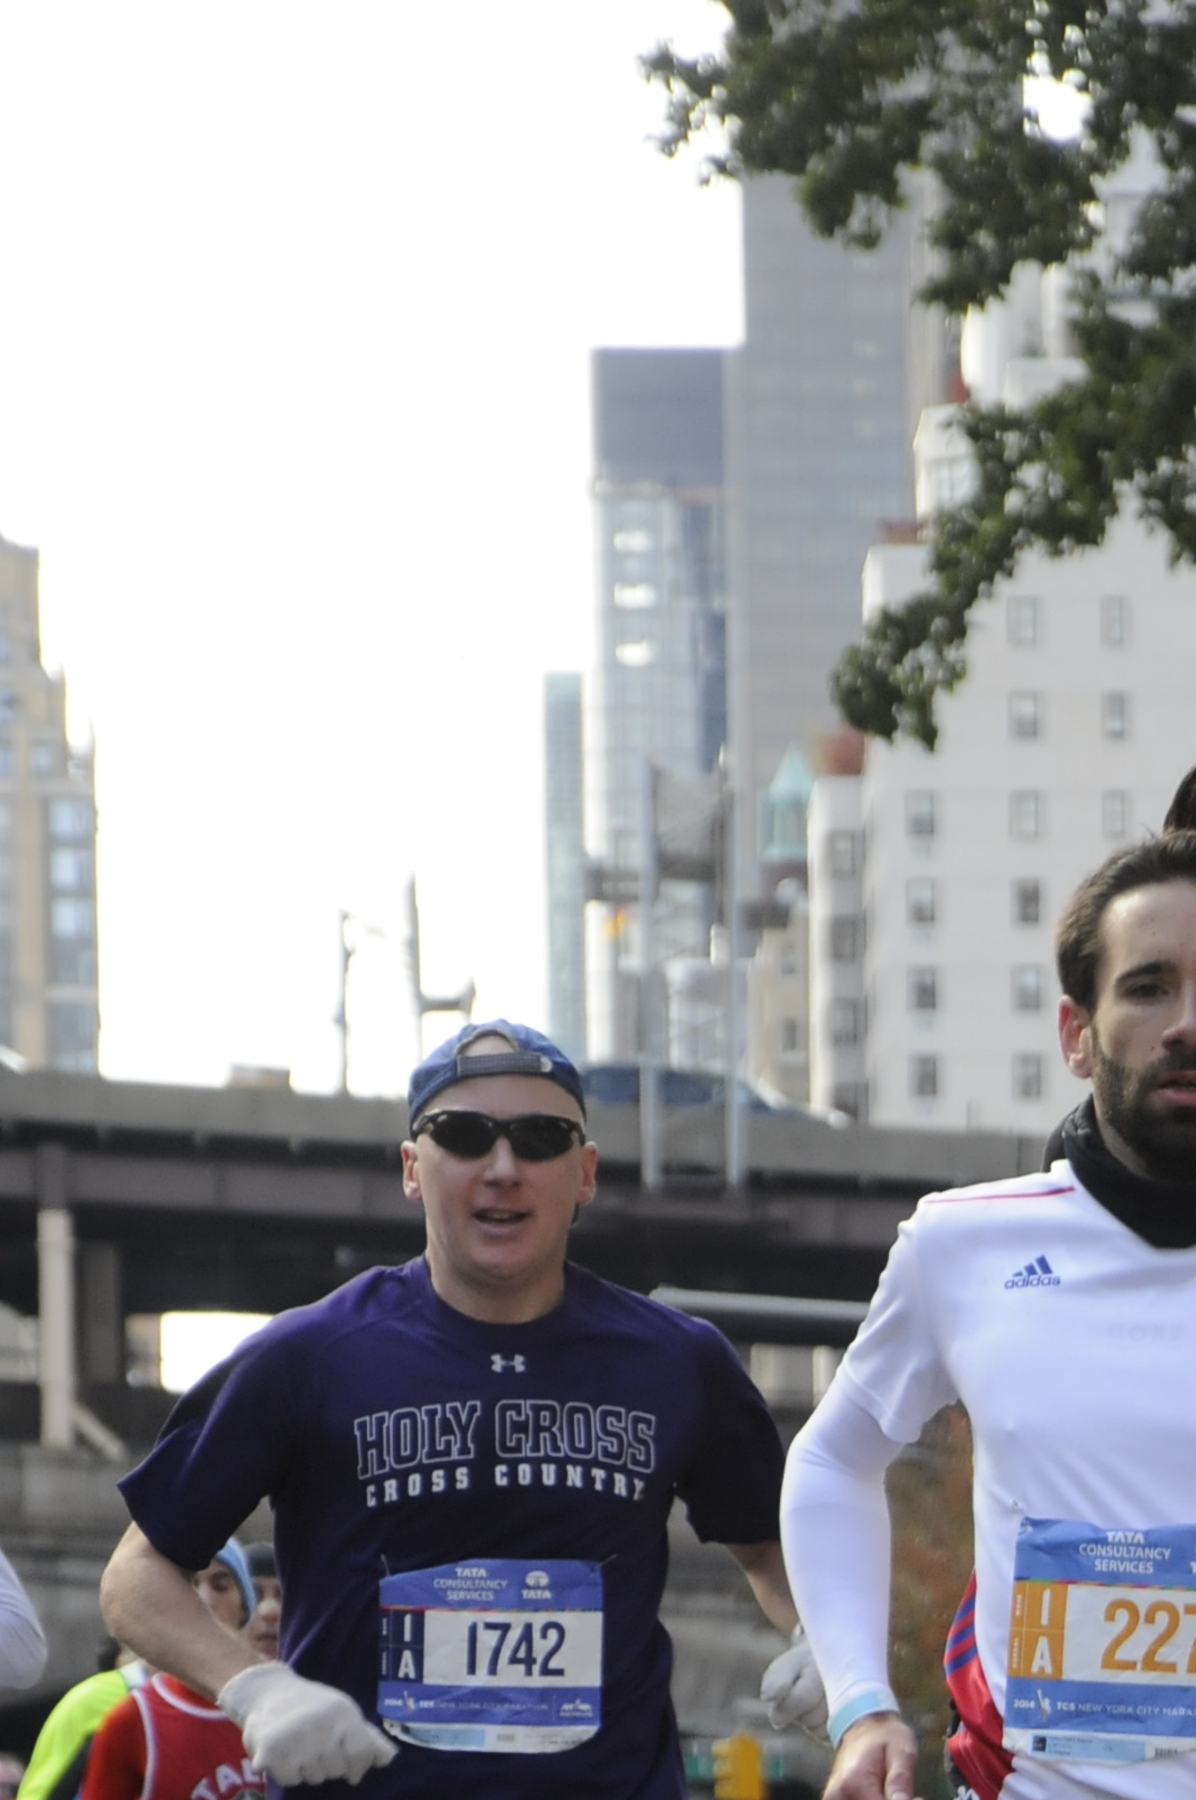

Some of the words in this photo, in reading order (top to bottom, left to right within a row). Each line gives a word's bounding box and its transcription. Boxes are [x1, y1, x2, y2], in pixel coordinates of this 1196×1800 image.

[1004, 1274, 1061, 1289] adidas
[354, 1400, 481, 1480] HOLY
[495, 1399, 656, 1474] CROSS
[366, 1466, 470, 1507] CROSS
[495, 1463, 645, 1501] COUNTRY
[1106, 1530, 1145, 1544] TATA
[1079, 1543, 1171, 1561] CONSULTANCY
[455, 1567, 487, 1578] TATA
[1094, 1558, 1154, 1574] SERVICES
[433, 1579, 508, 1590] CONSULTANCY
[447, 1590, 494, 1601] SERVICES
[521, 1589, 552, 1599] TATA
[466, 1621, 566, 1677] 1742
[1031, 1635, 1052, 1674] A
[398, 1650, 416, 1679] A
[1013, 1699, 1036, 1709] 2014
[1057, 1701, 1076, 1711] TCS
[1078, 1703, 1103, 1713] NEW
[1106, 1704, 1133, 1715] YORK
[1136, 1706, 1160, 1716] CITY
